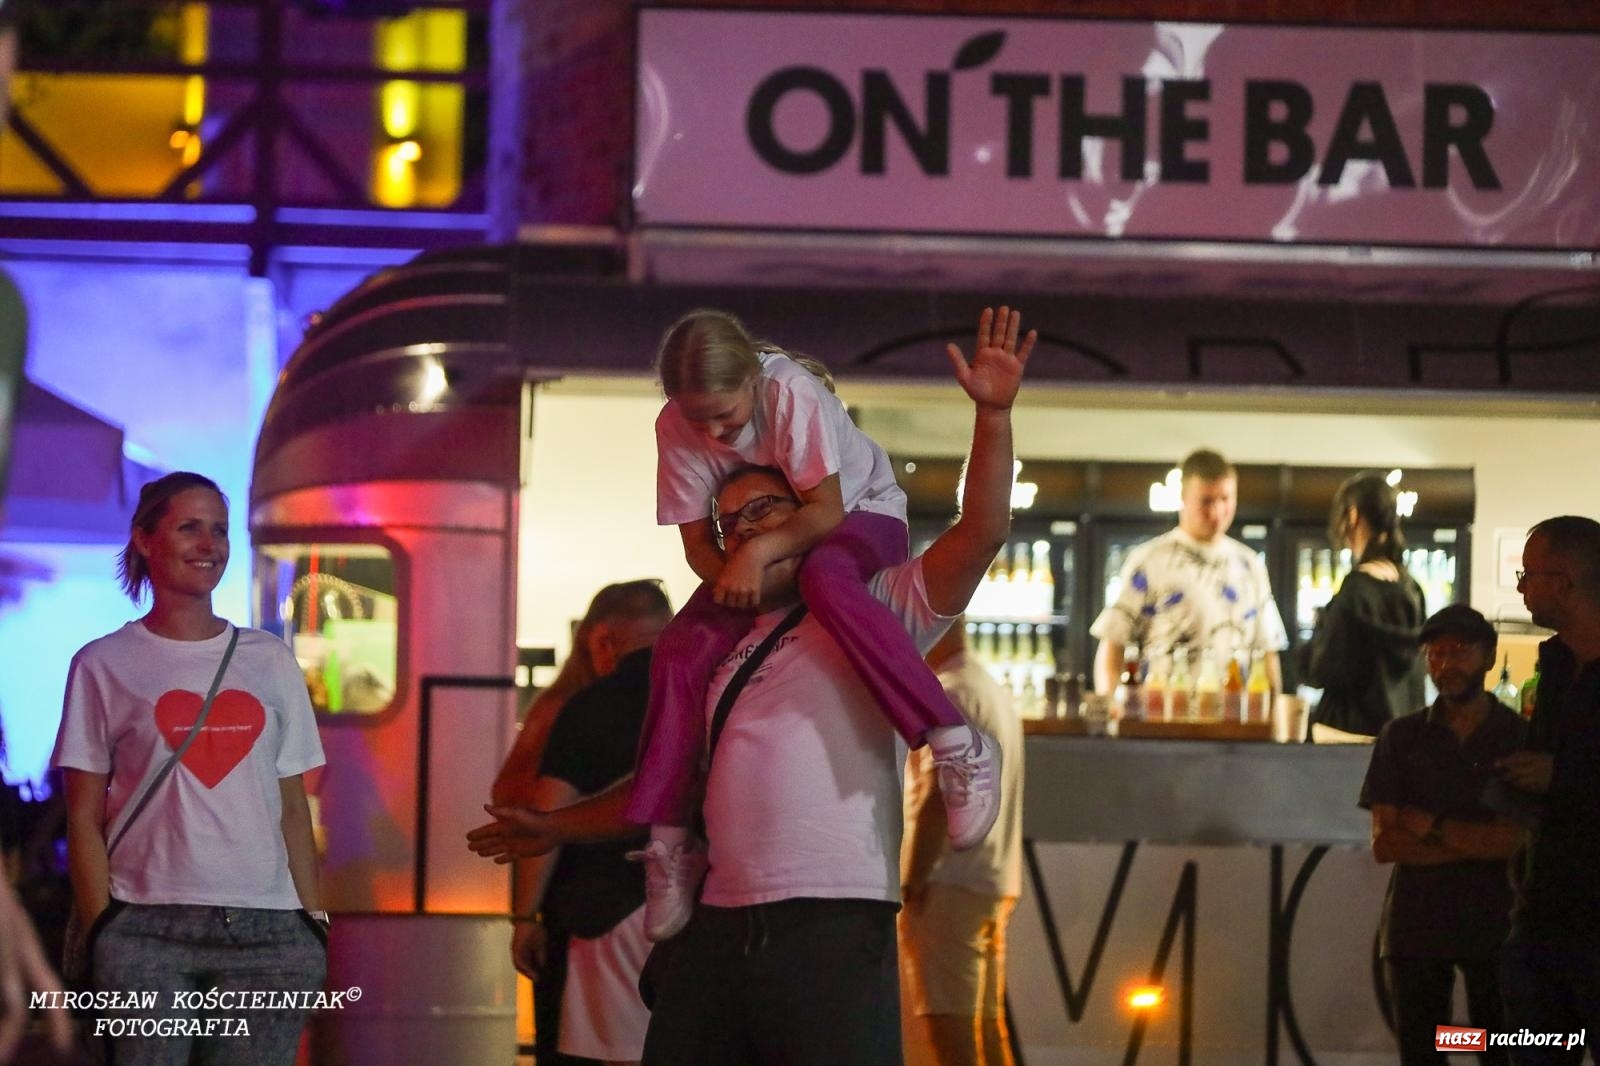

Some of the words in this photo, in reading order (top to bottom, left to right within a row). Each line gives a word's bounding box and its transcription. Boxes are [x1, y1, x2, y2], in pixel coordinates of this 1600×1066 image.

[747, 66, 952, 176] ON
[991, 73, 1210, 184] THE
[1244, 79, 1502, 190] BAR
